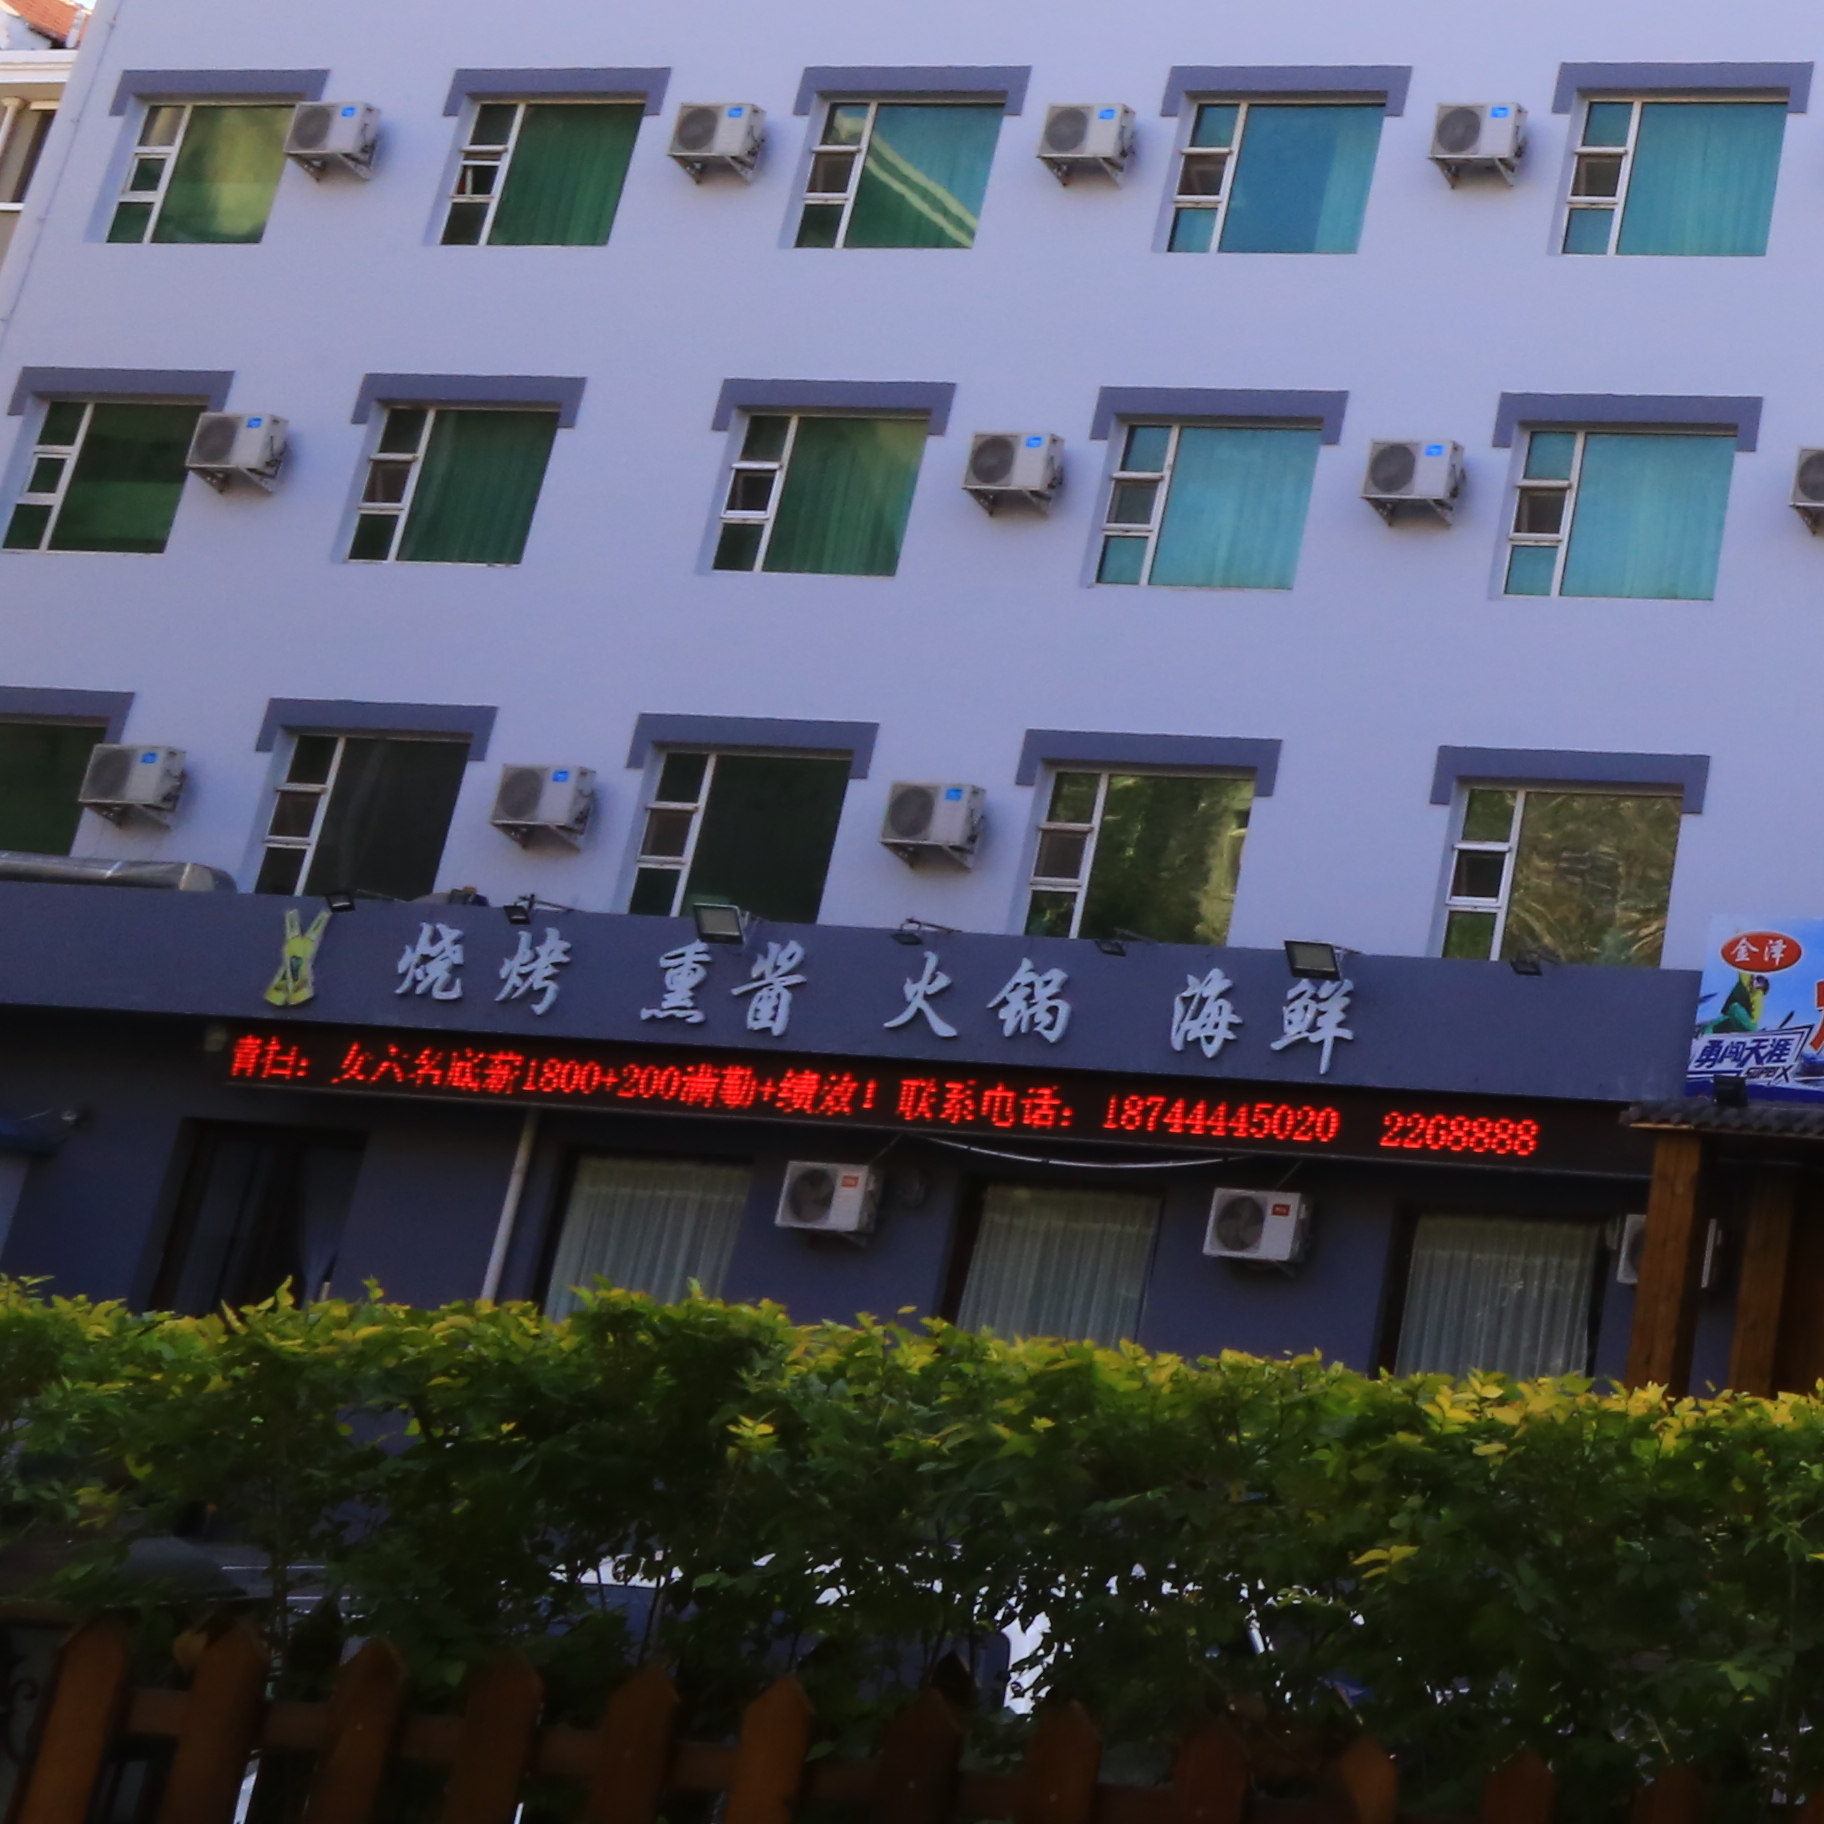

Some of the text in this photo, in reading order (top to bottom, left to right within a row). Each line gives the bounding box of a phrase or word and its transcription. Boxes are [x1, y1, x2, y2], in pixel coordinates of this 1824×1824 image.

[1730, 937, 1788, 966] 金泽
[395, 921, 1355, 1075] 烧烤 熏酱 火锅 海鲜
[1694, 1037, 1795, 1069] 勇闯天涯
[1102, 1094, 1341, 1143] 18744445020
[1378, 1111, 1541, 1157] 2268888
